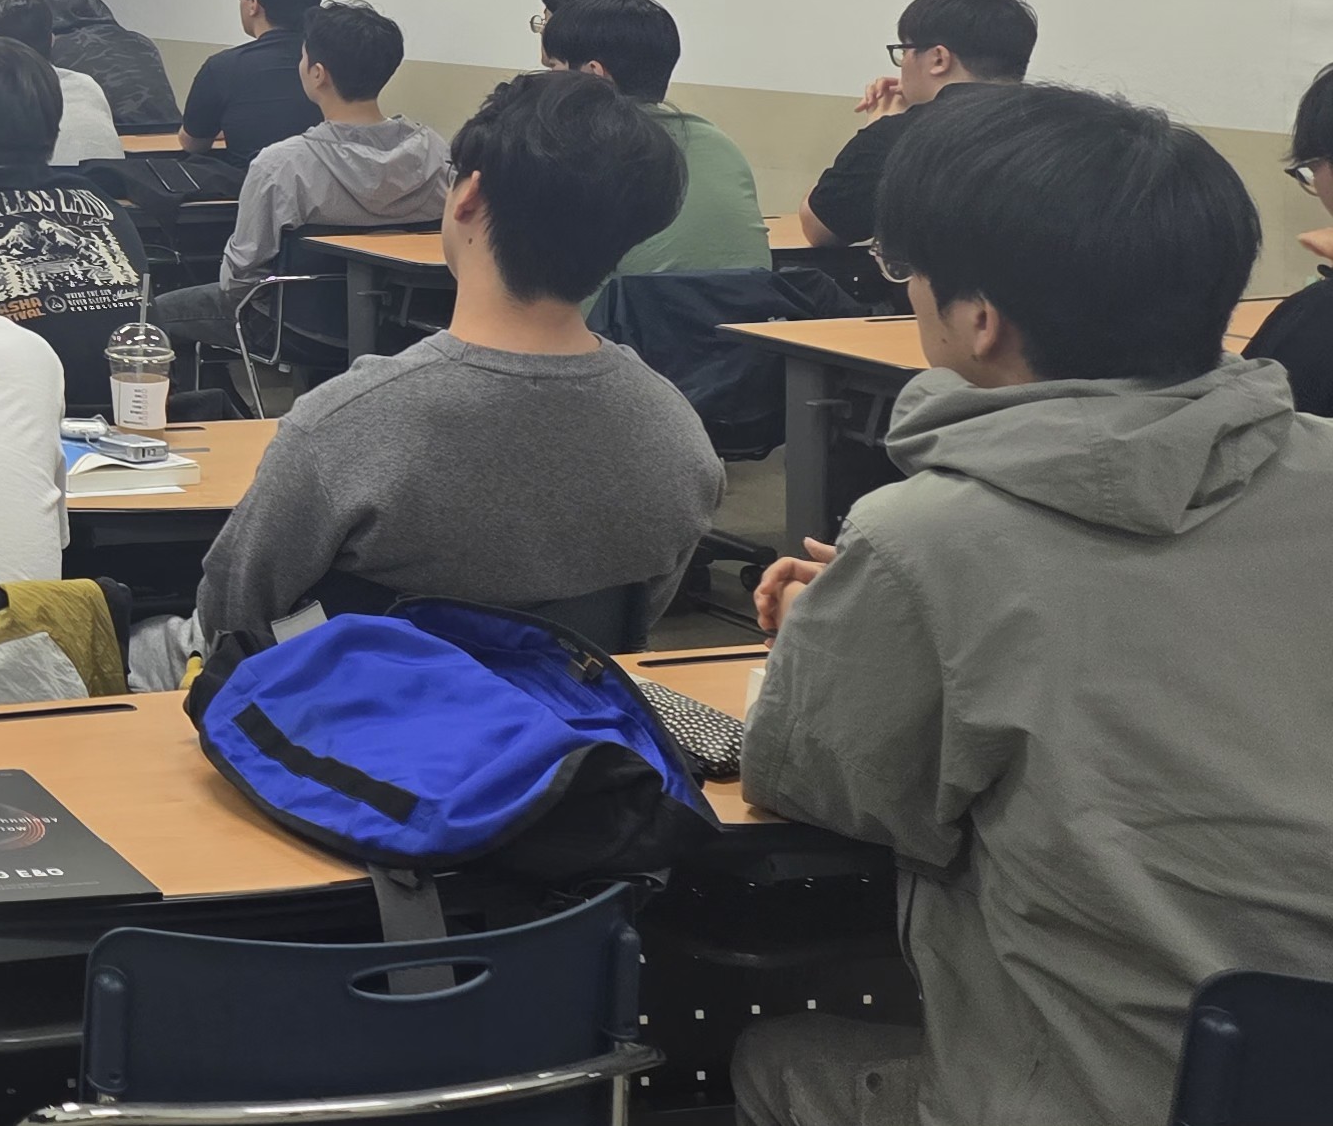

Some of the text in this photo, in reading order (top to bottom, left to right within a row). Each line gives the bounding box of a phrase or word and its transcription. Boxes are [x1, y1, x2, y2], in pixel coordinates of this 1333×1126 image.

[54, 187, 114, 221] LAND
[5, 307, 46, 321] TIVAL
[14, 867, 65, 879] E&G
